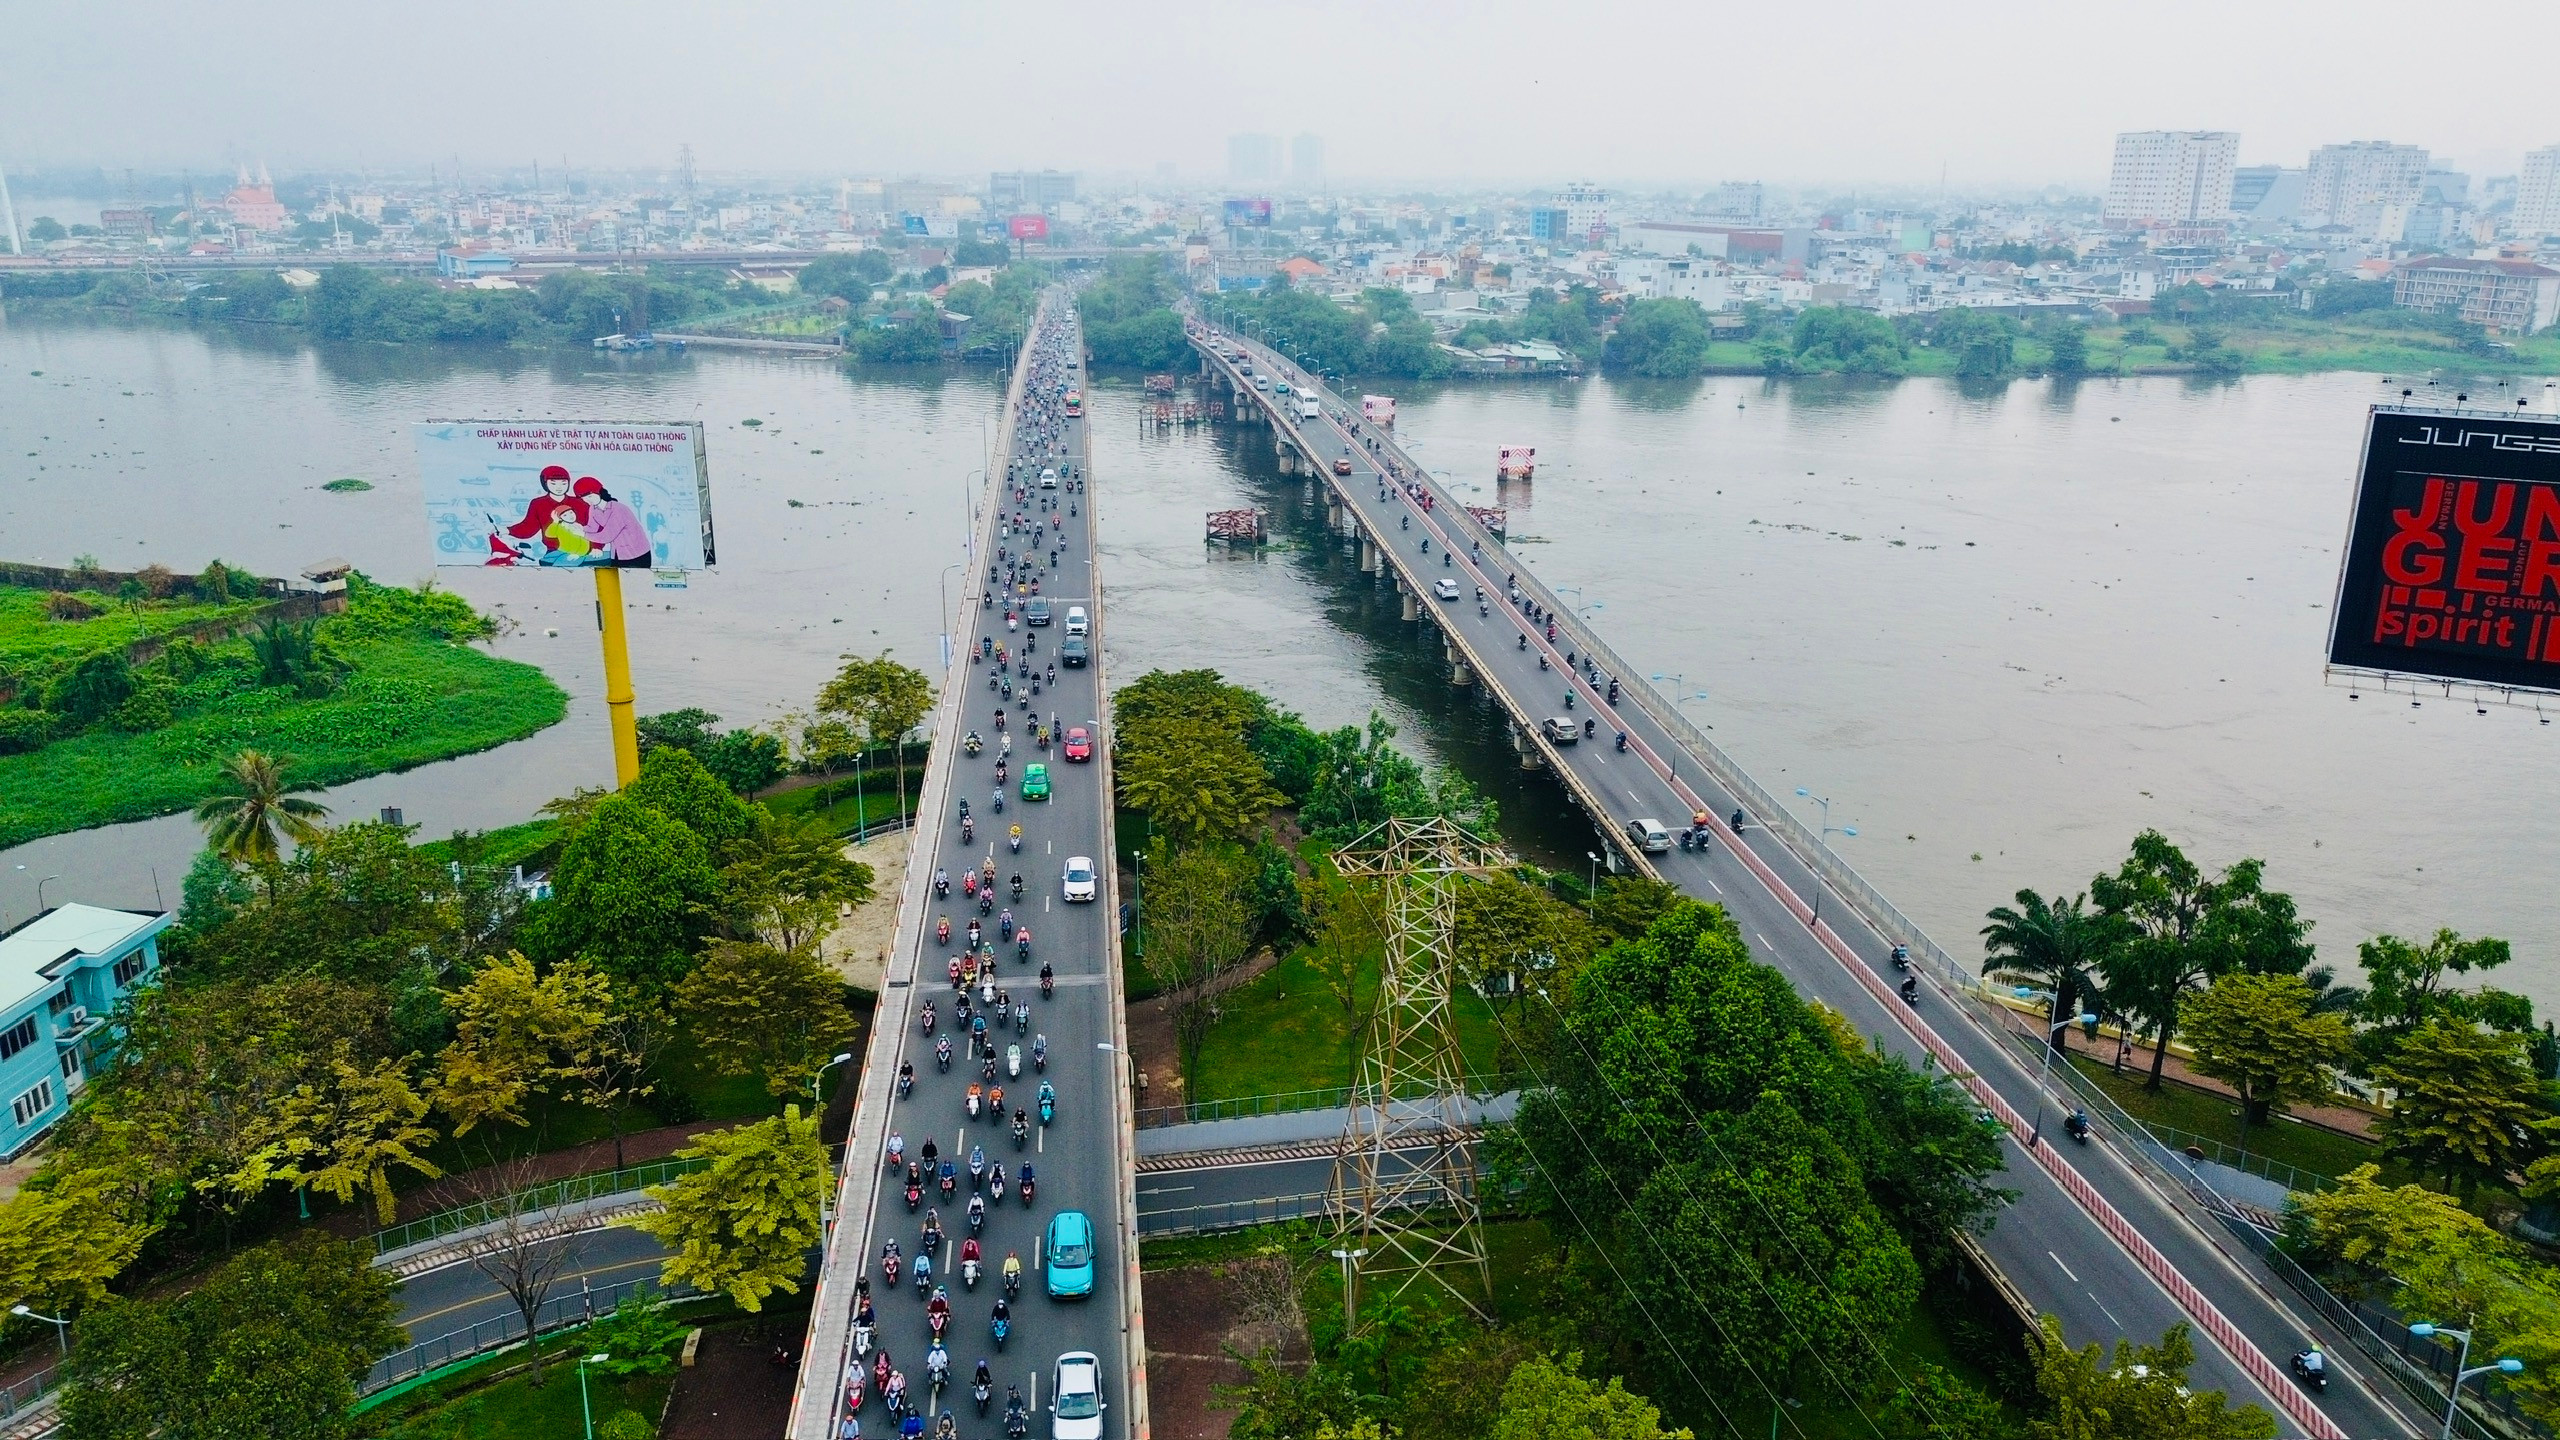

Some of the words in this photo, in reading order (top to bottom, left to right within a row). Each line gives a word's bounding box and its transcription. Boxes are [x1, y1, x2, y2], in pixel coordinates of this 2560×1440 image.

[477, 427, 499, 438] CHẤP
[502, 428, 525, 438] HÀNH
[528, 428, 548, 440] LUẬT
[550, 427, 560, 439] VỀ
[562, 429, 582, 440] TRẬT
[584, 430, 596, 441] TỰ
[598, 431, 609, 439] AN
[611, 430, 634, 440] TOÀN
[636, 432, 656, 441] GIAO
[658, 431, 687, 441] THÔNG
[497, 439, 513, 450] XÂY
[515, 441, 539, 451] DỰNG
[541, 439, 557, 450] NẾP
[560, 440, 583, 451] SỐNG
[584, 441, 601, 451] VĂN
[603, 442, 621, 451] HÓA
[623, 443, 643, 452] GIAO
[644, 442, 673, 453] THÔNG
[2438, 482, 2456, 530] GERMAN
[2381, 530, 2560, 597] GER
[2511, 541, 2528, 587] JUNGER
[2484, 594, 2560, 612] GERMA
